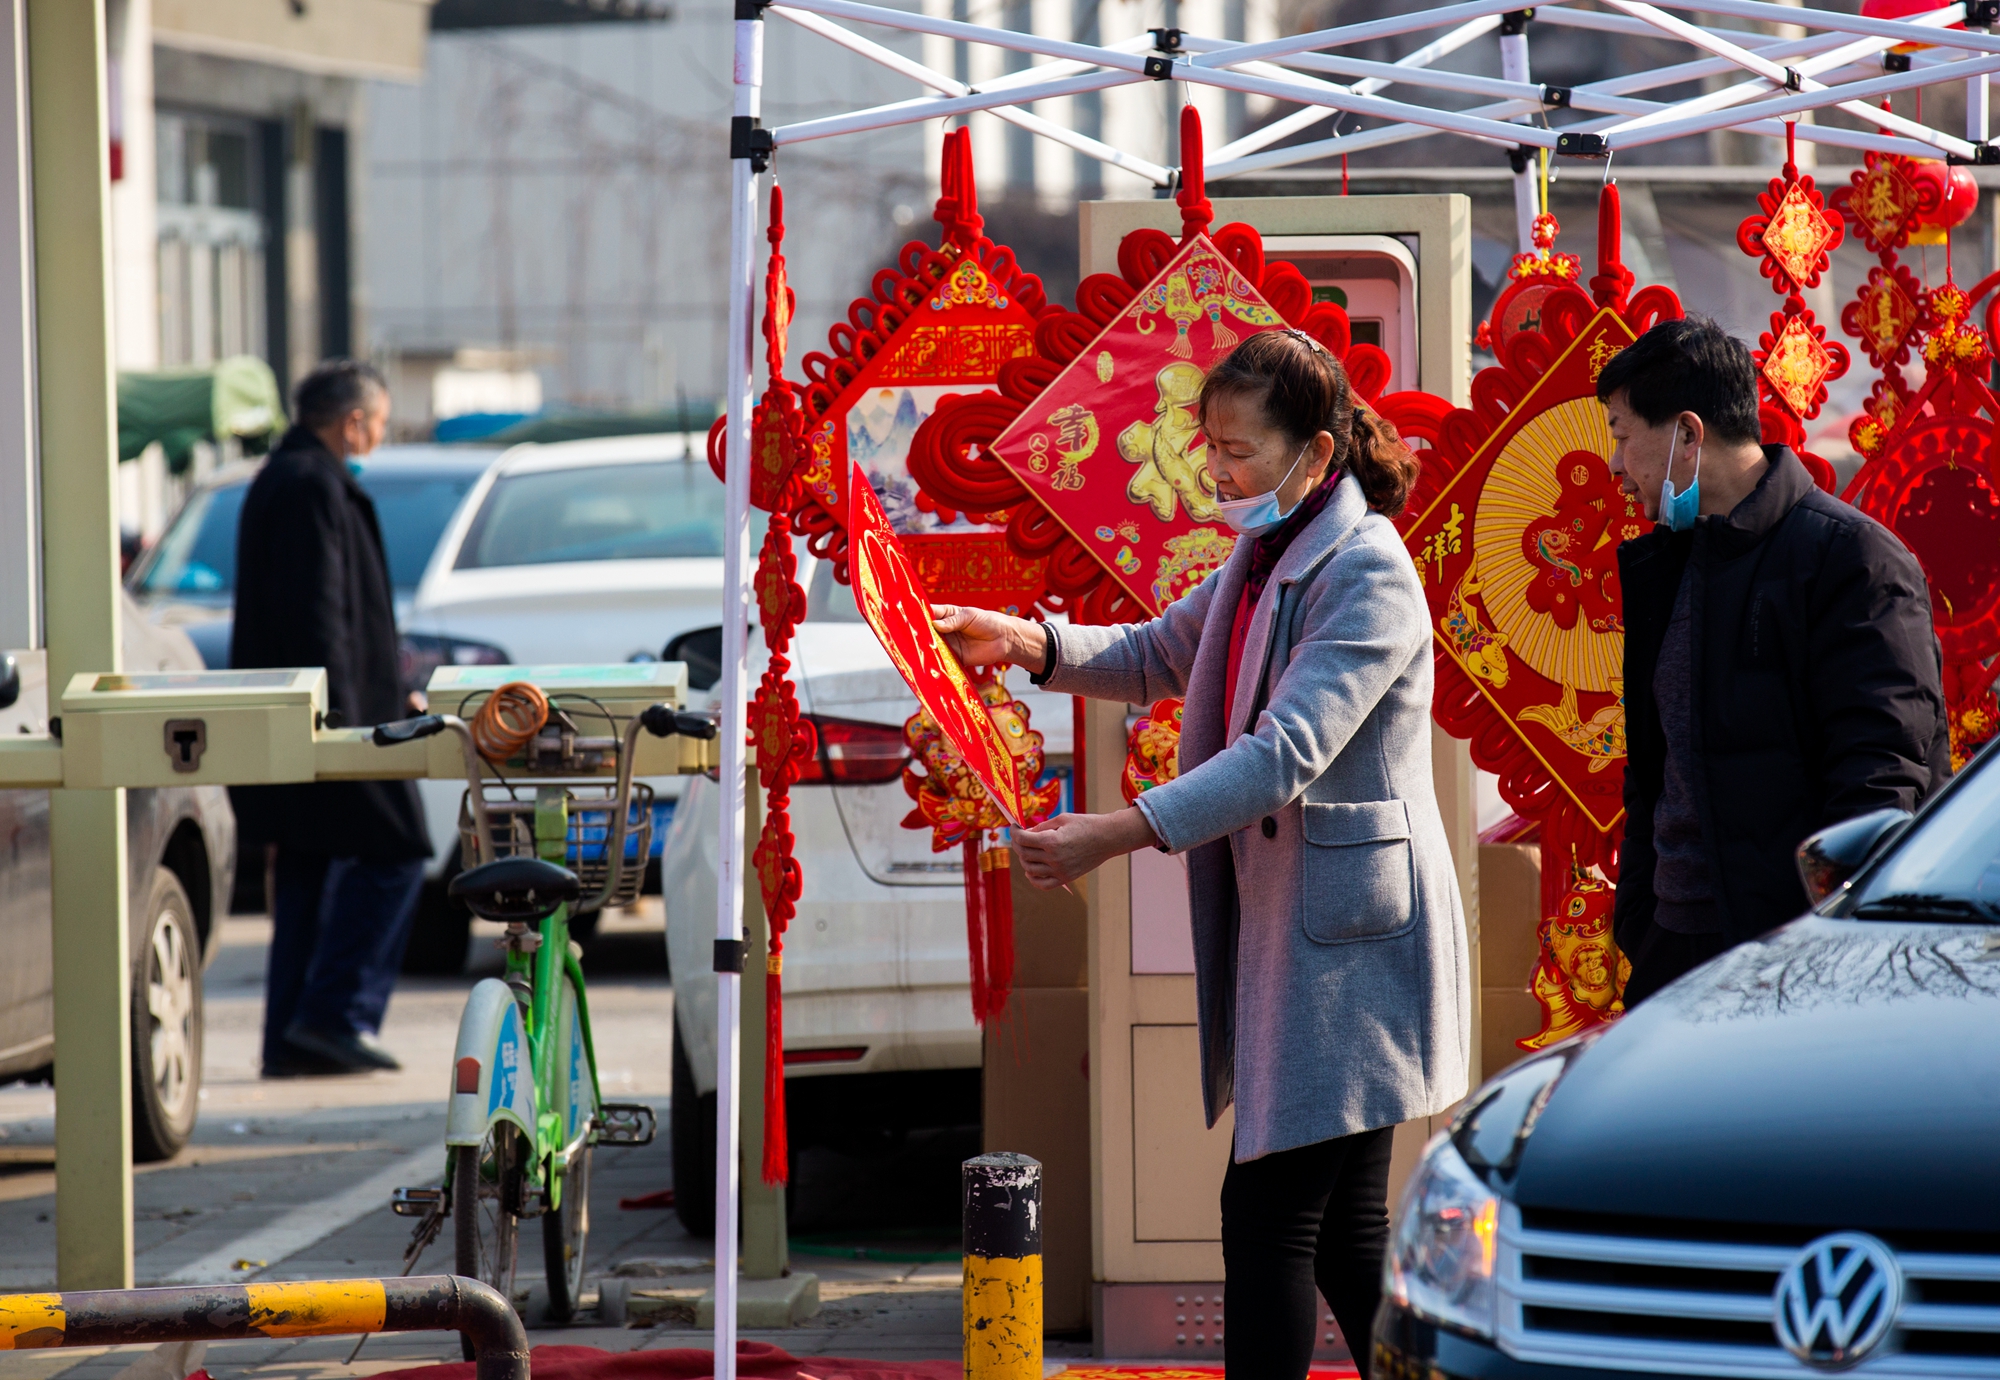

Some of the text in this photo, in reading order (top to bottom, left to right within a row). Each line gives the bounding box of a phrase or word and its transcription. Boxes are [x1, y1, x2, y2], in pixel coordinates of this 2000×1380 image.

[1781, 203, 1815, 255] 福
[1872, 291, 1900, 341] 喜
[1781, 333, 1814, 385] 福
[1050, 403, 1094, 491] 幸福
[1421, 503, 1465, 585] 吉祥
[1576, 950, 1608, 984] 福
